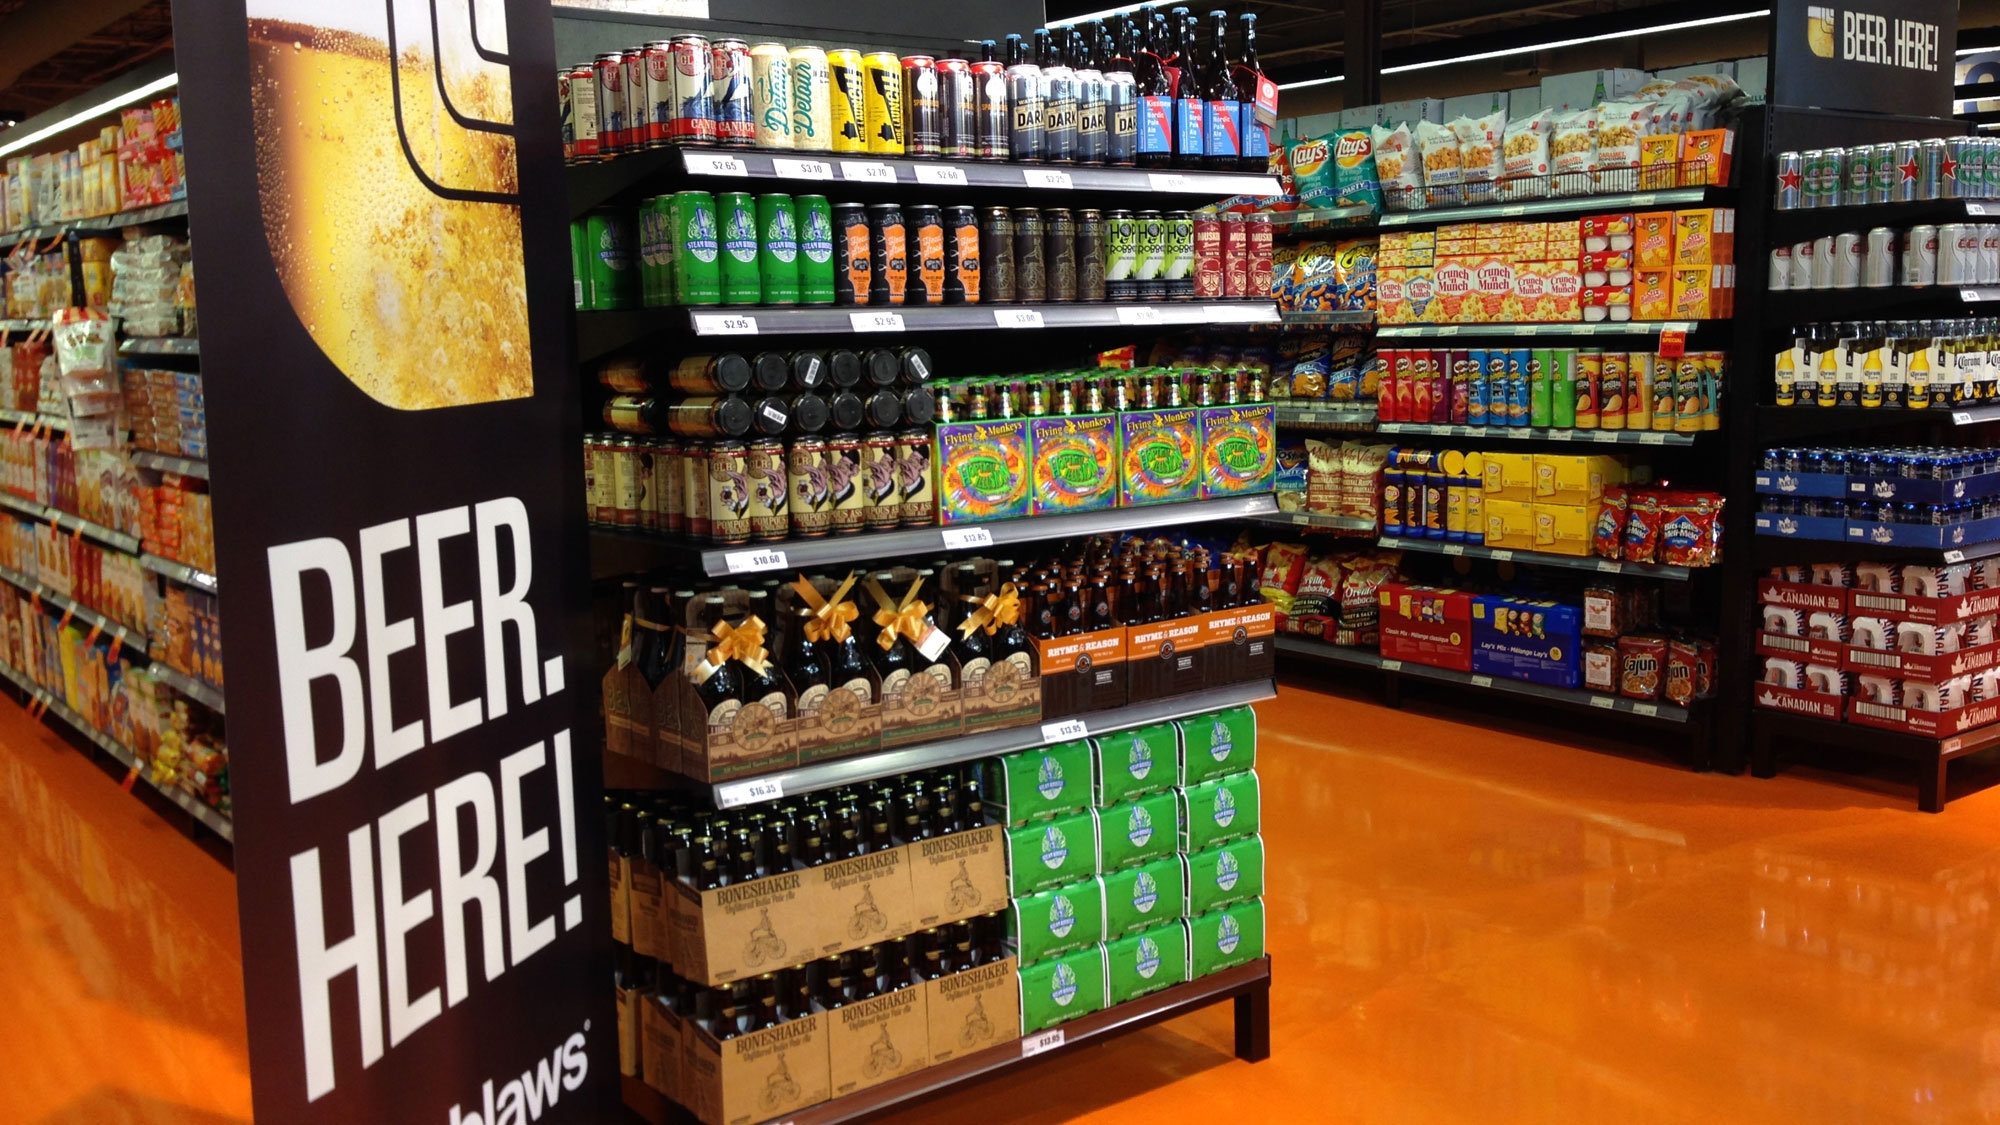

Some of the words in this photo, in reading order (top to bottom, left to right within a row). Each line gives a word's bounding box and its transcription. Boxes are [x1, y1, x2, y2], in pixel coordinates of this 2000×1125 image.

[1843, 10, 1891, 65] BEER.
[1895, 18, 1939, 71] HERE!
[1437, 268, 1469, 280] Crunch
[1477, 266, 1511, 280] Crunch
[1478, 277, 1510, 291] Munch
[1438, 280, 1469, 292] Munch
[723, 319, 749, 330] $2.95
[1036, 425, 1063, 440] Flying
[1076, 415, 1111, 430] Monkeys
[1126, 419, 1151, 433] Flying
[1163, 410, 1195, 424] Monkeys
[1206, 414, 1230, 429] Flying
[1240, 405, 1272, 421] Monkeys
[944, 432, 973, 447] Flying
[988, 421, 1023, 435] Monkeys
[754, 555, 781, 567] $10.60
[1303, 575, 1326, 587] rville
[1780, 590, 1826, 607] CANADIAN
[1208, 616, 1237, 631] RHYME
[1242, 611, 1271, 626] REASON
[1134, 629, 1163, 644] RHYME
[1168, 624, 1199, 640] REASON
[267, 496, 566, 805] BEER.
[1047, 642, 1078, 658] RHYME
[1085, 636, 1120, 653] REASON
[1623, 655, 1657, 676] Cajun
[1776, 693, 1821, 714] CANADIAN
[922, 828, 994, 858] BONESHAKER
[823, 850, 899, 882] BONESHAKER
[717, 873, 800, 907] BONESHAKER
[290, 728, 584, 1103] HERE!
[939, 961, 1009, 995] BONESHAKER
[842, 989, 918, 1024] BONESHAKER
[736, 1017, 818, 1055] BONESHAKER
